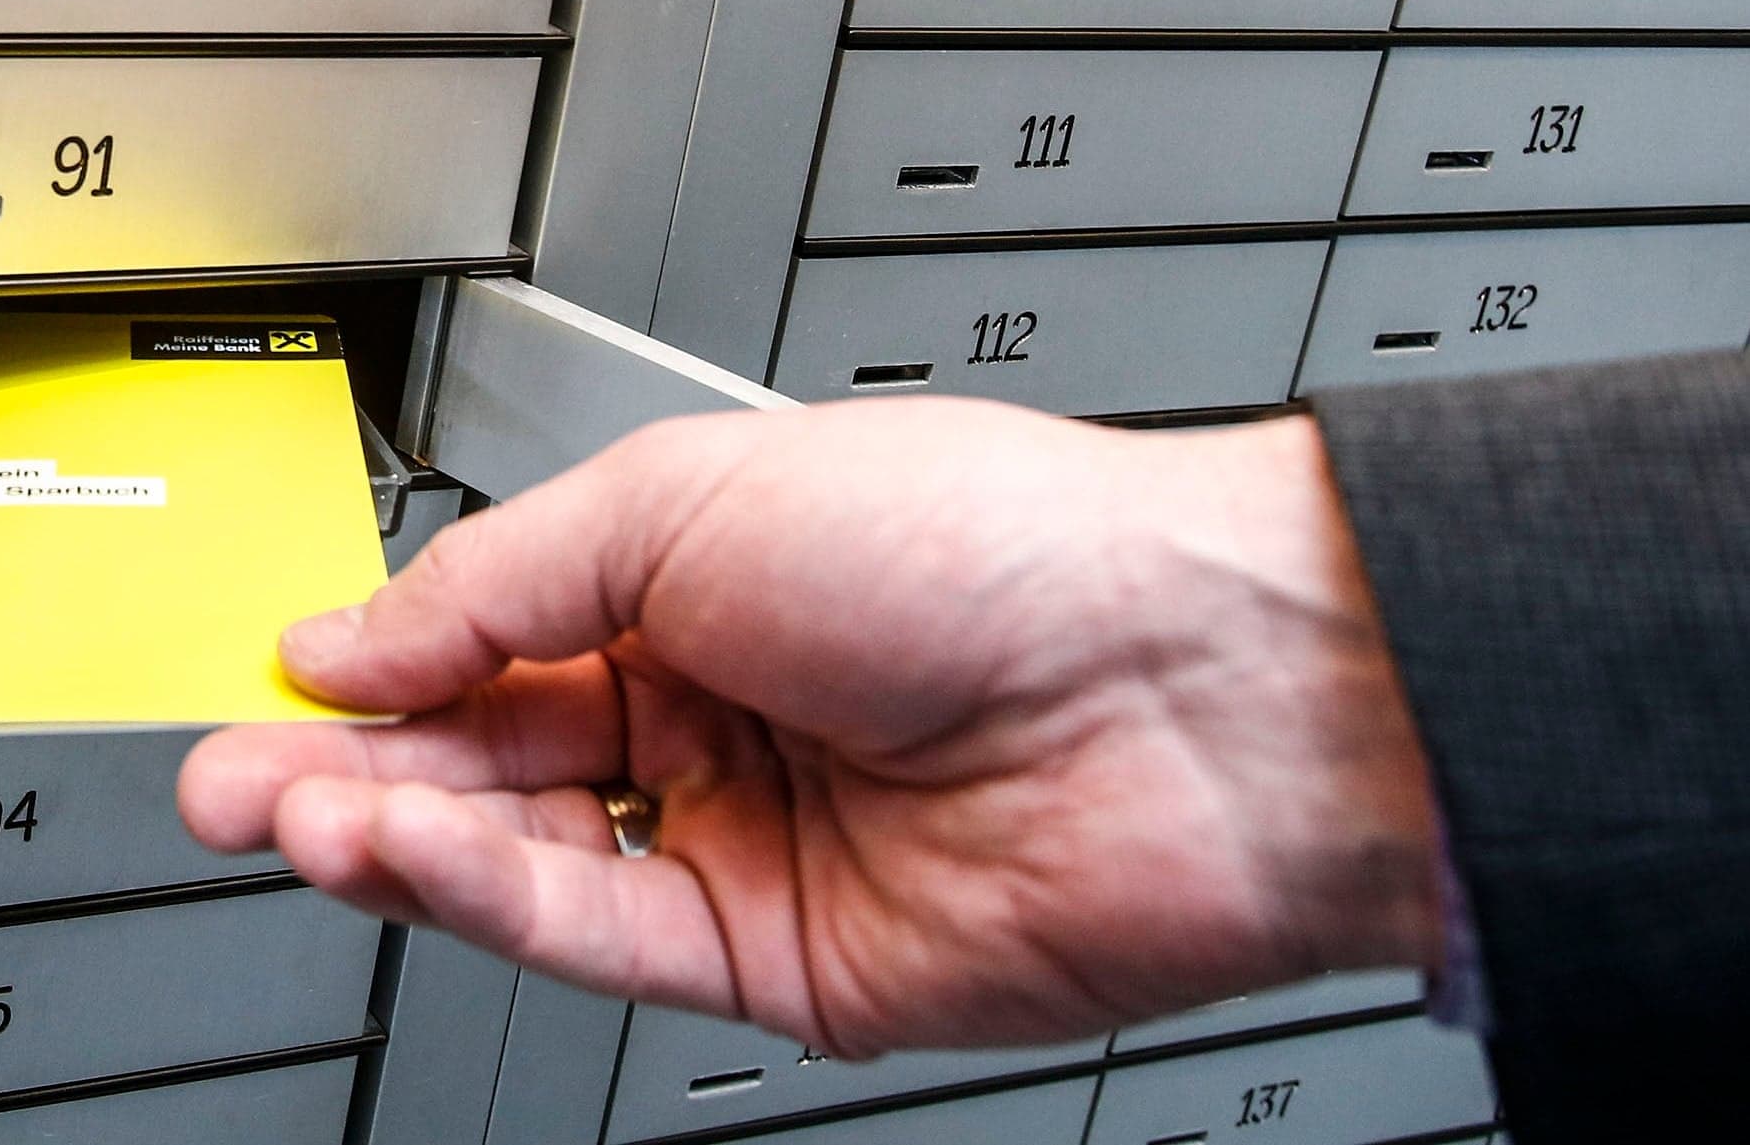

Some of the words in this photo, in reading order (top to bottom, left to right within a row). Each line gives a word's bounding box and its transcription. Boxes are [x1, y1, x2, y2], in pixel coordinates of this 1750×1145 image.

[1014, 114, 1076, 169] 111
[1522, 105, 1584, 155] 131
[51, 135, 114, 197] 91
[1469, 284, 1538, 333] 132
[153, 343, 208, 352] Meine
[214, 343, 262, 353] Bank
[173, 335, 260, 344] Raiffeisen
[967, 311, 1038, 365] 112
[6, 486, 149, 497] Sparbuch
[1235, 1079, 1300, 1128] 137
